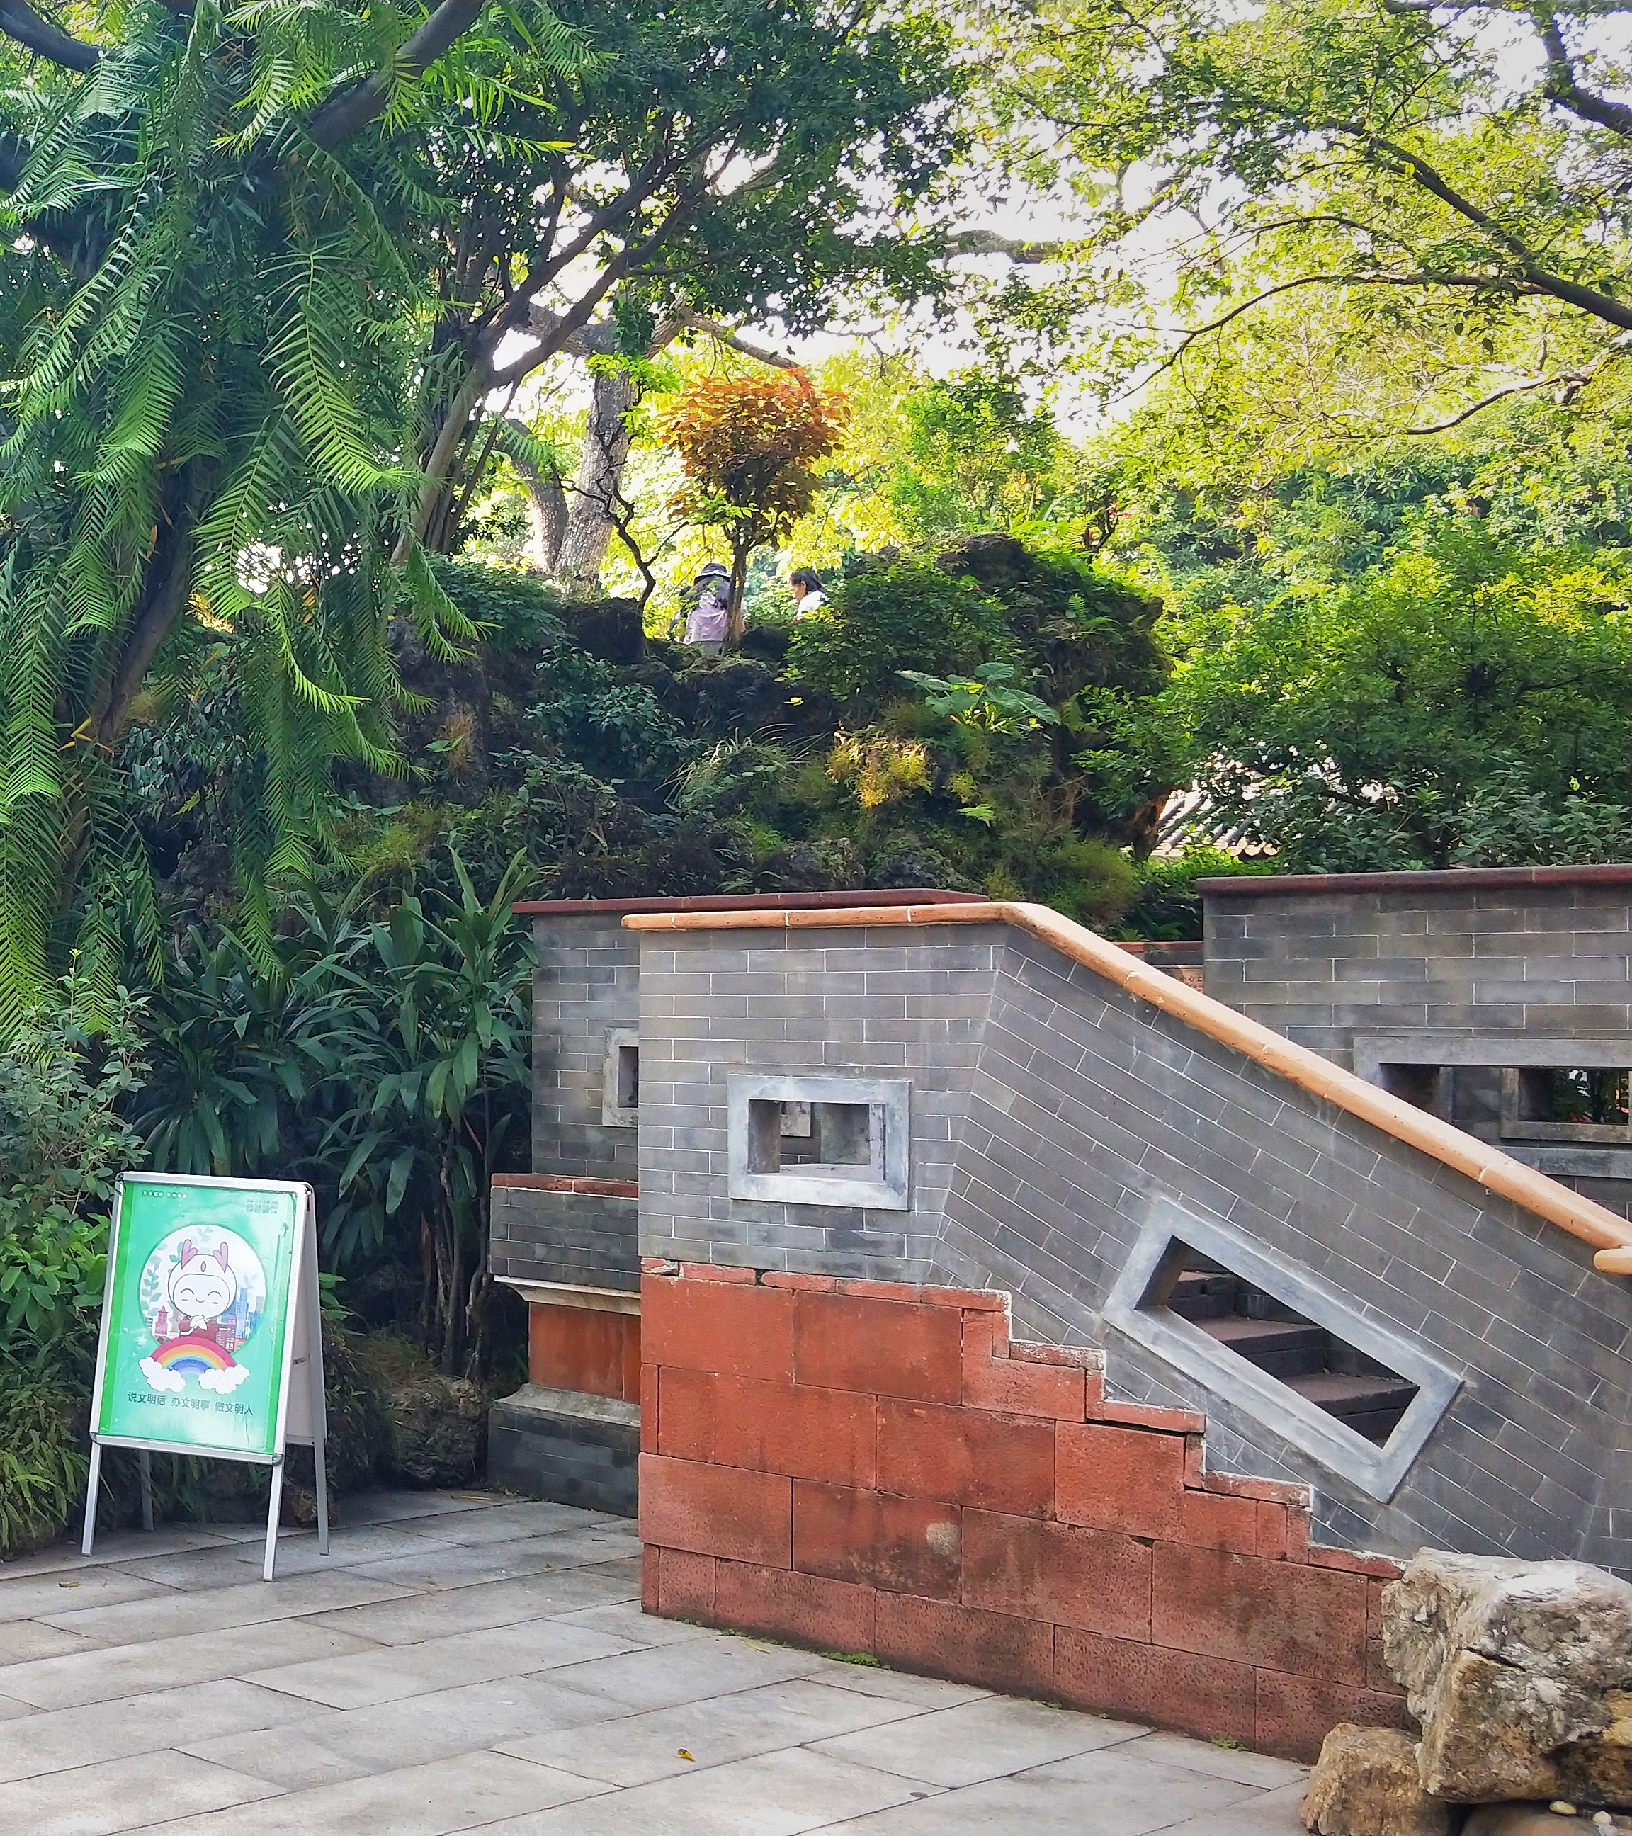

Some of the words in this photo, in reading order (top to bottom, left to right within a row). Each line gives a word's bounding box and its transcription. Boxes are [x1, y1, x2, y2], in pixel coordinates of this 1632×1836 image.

[128, 1391, 166, 1406] 说文明话
[171, 1397, 210, 1410] 办文明事
